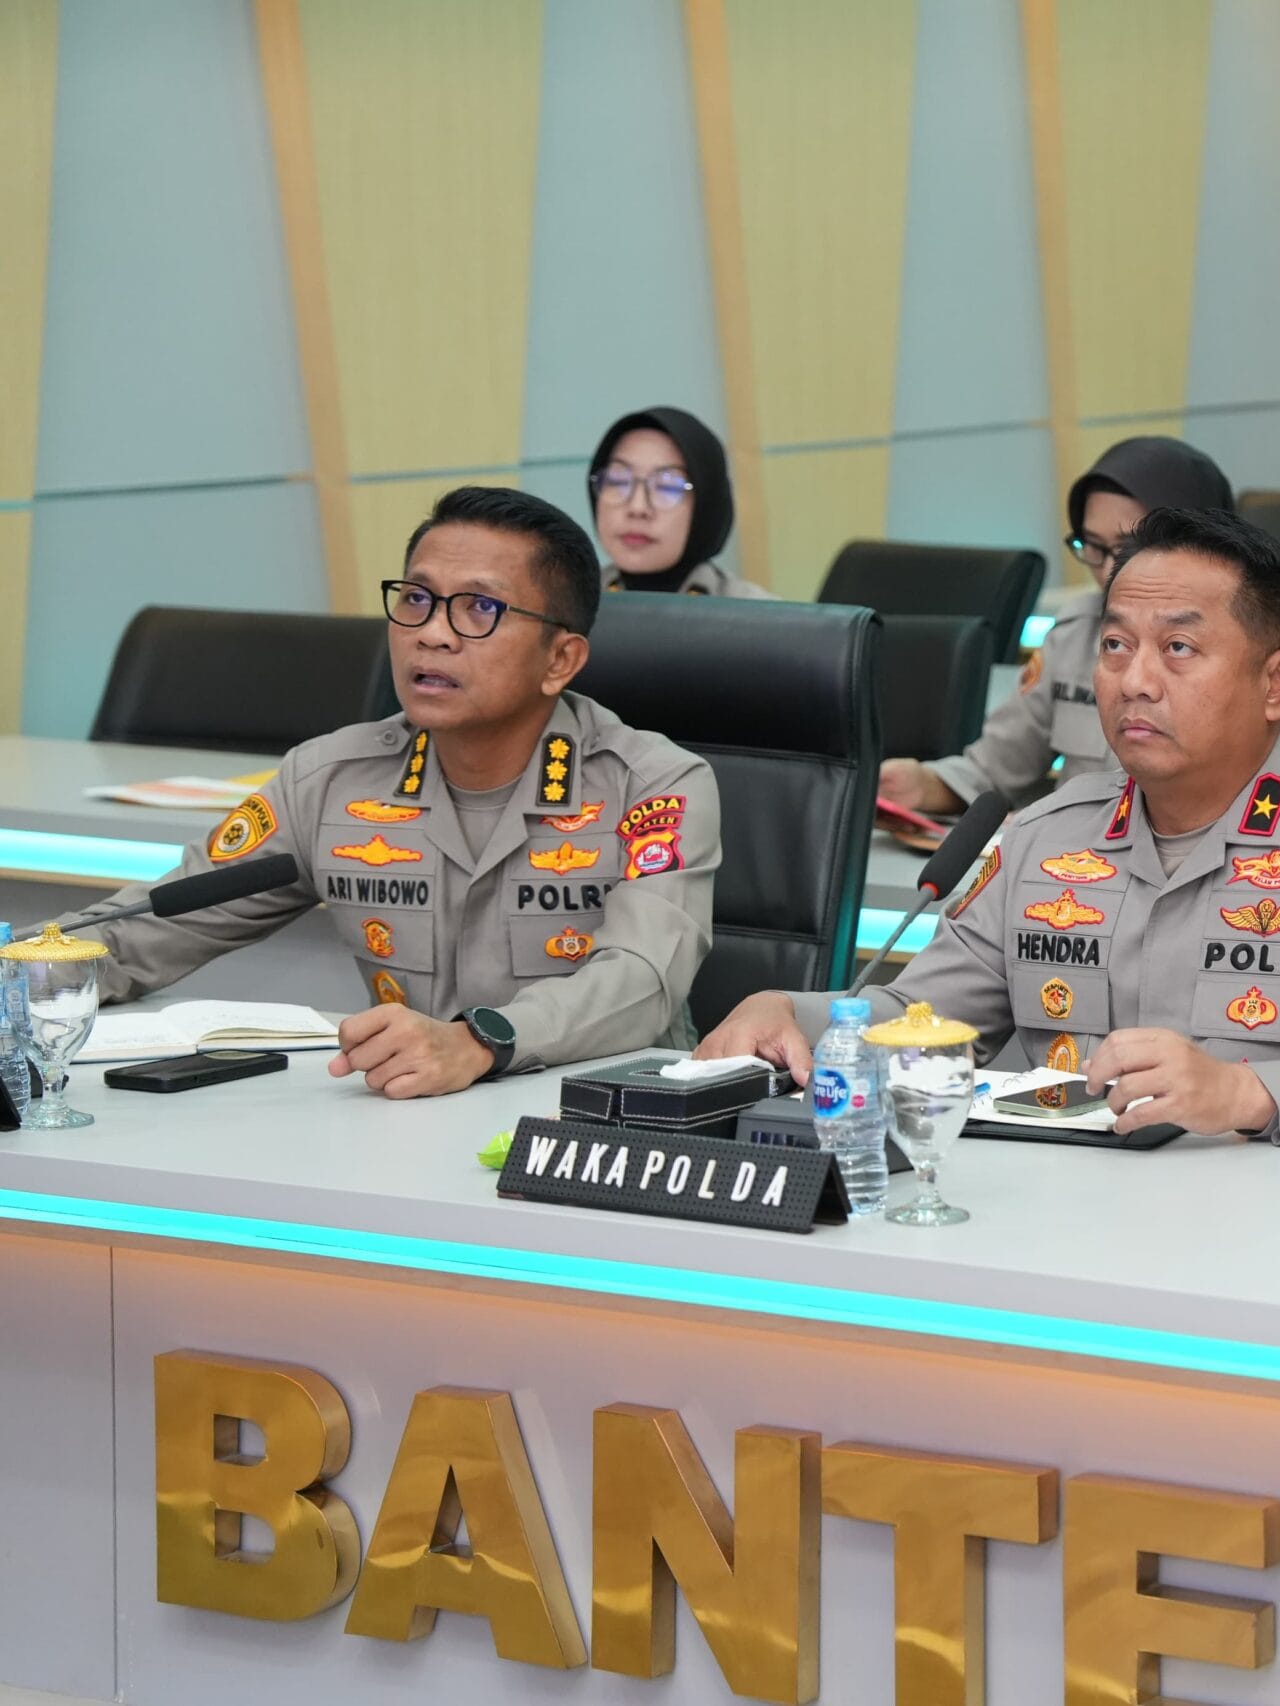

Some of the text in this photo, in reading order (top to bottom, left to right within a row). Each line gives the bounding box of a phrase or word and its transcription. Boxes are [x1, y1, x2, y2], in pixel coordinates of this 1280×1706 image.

[621, 798, 680, 835] POLDA
[637, 816, 675, 833] ANTEN
[328, 876, 429, 906] ARI WIBOWO
[1018, 933, 1100, 966] HENDRA
